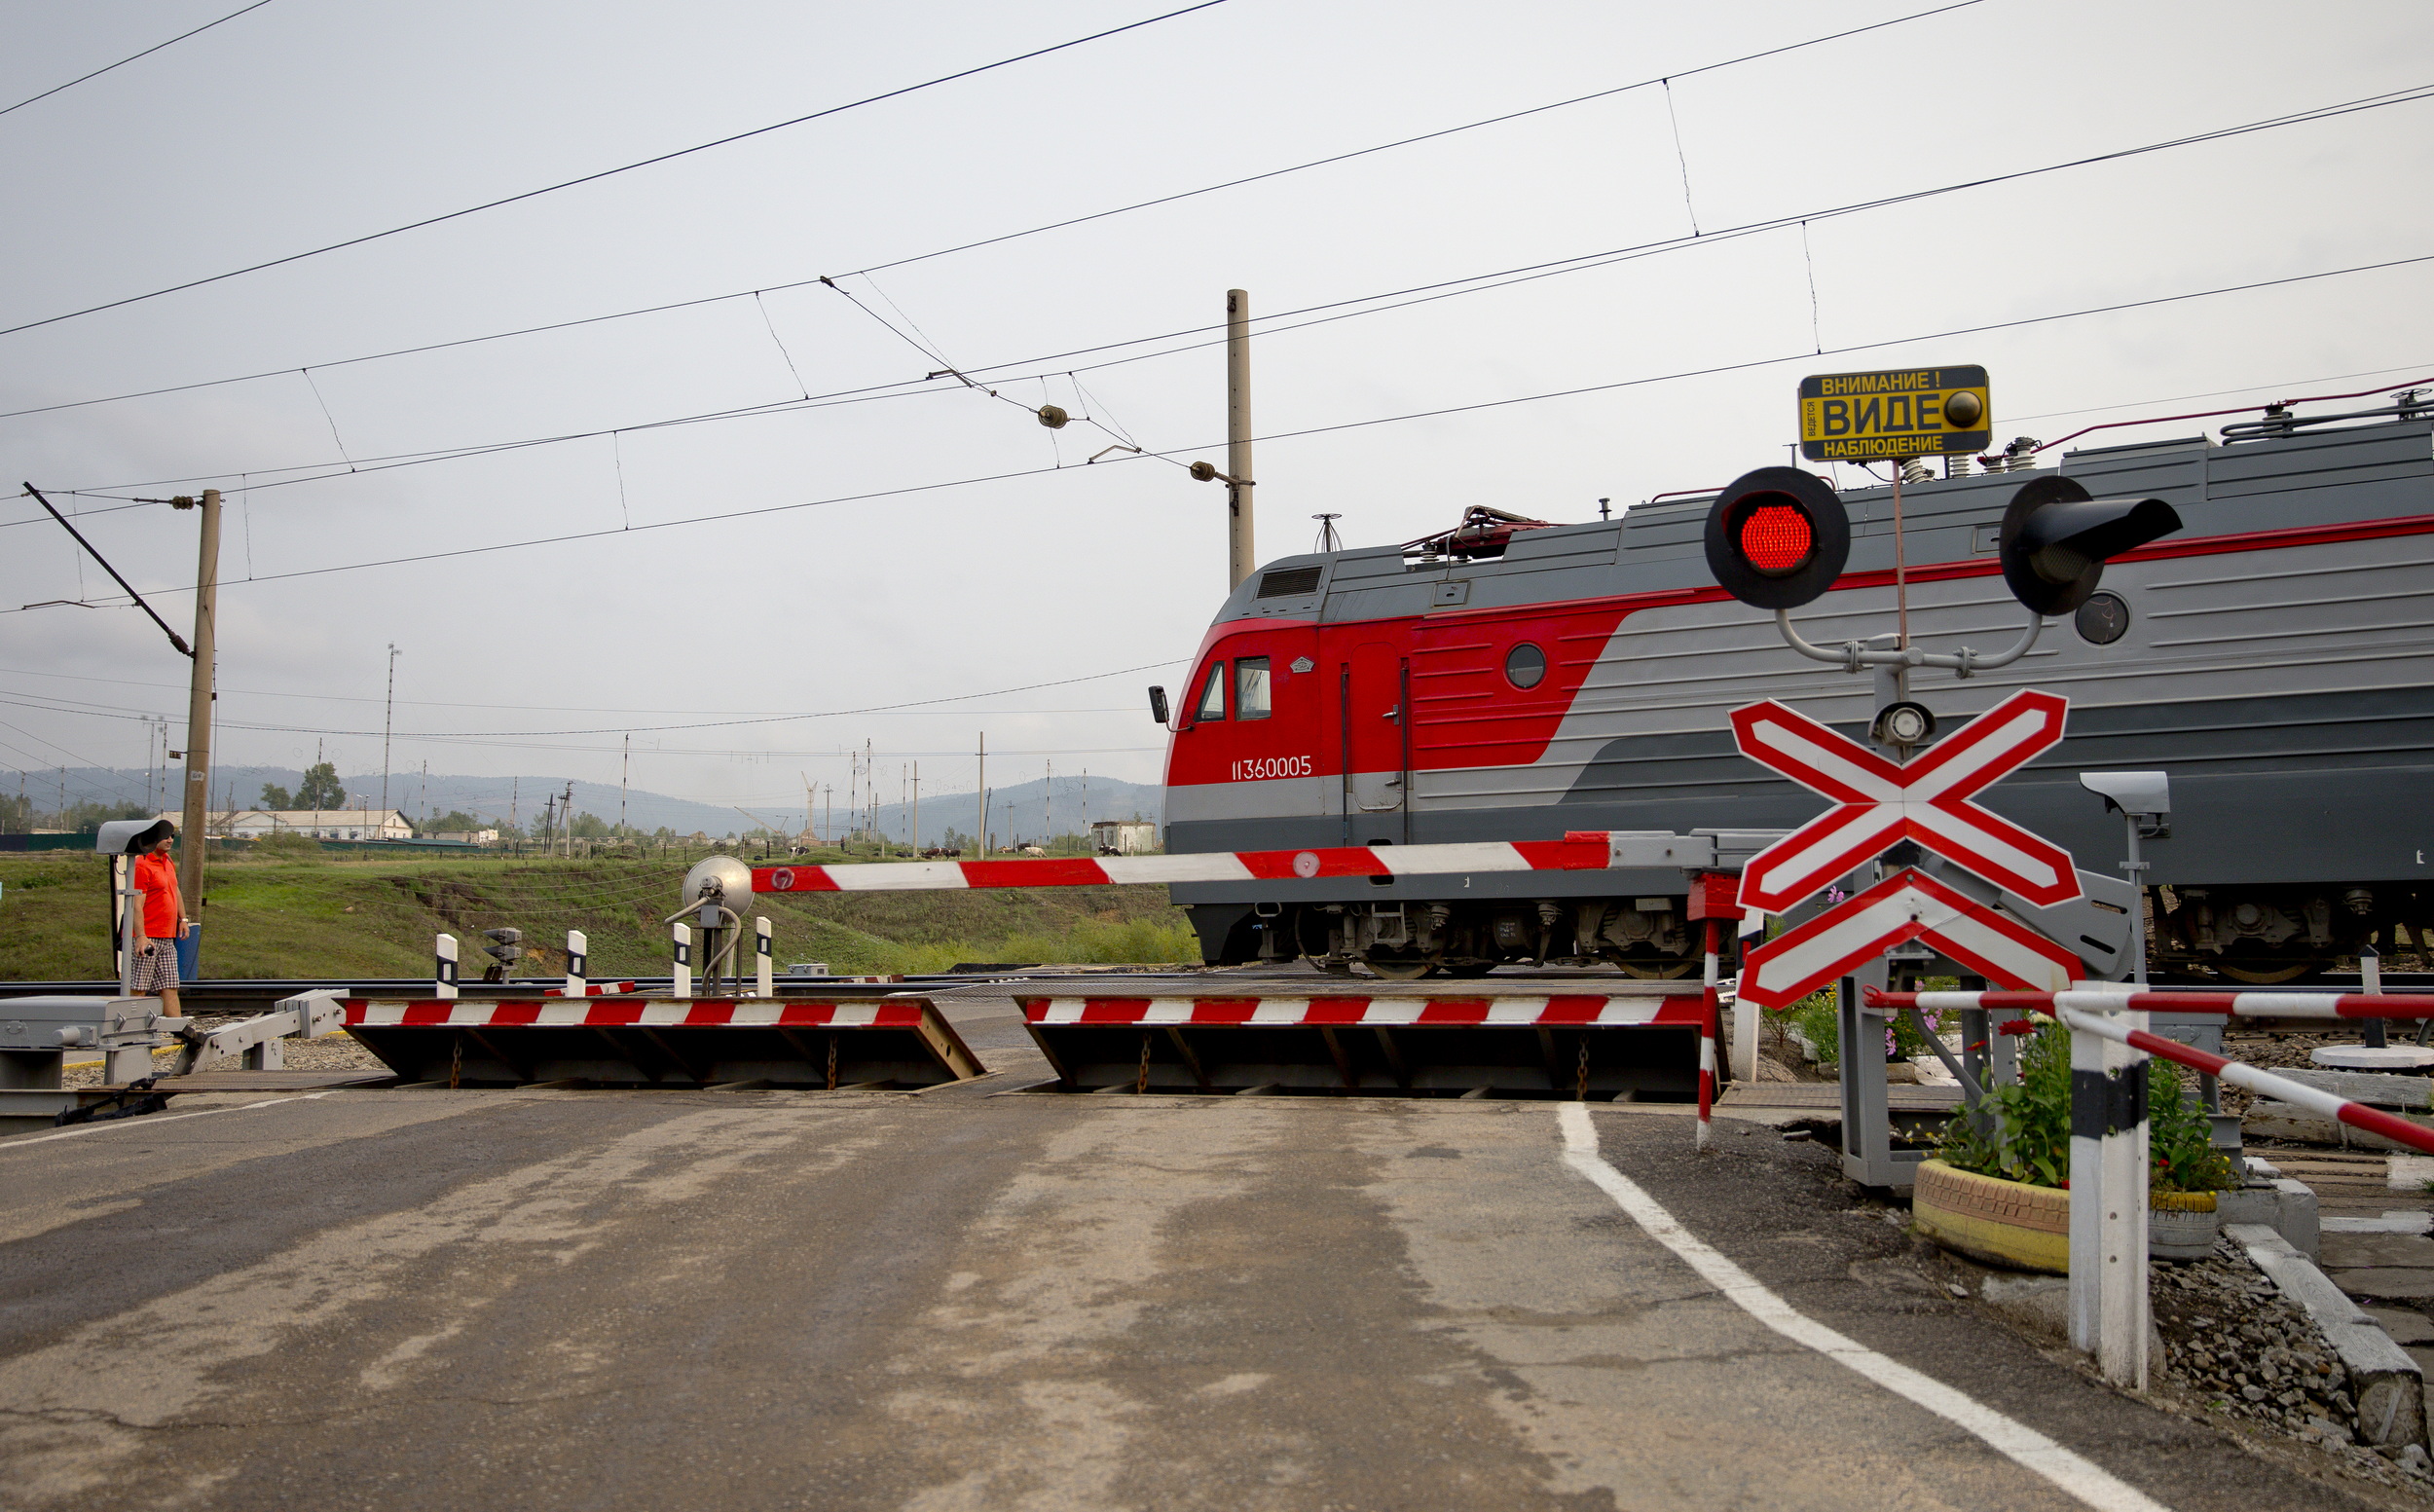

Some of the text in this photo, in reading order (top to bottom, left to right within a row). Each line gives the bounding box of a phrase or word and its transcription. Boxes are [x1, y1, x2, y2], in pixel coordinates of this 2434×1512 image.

[1822, 372, 1930, 395] ВНИМАНИЕ
[1824, 436, 1943, 457] НАБЛЮДЕНИЕ
[1232, 756, 1311, 780] 11360005
